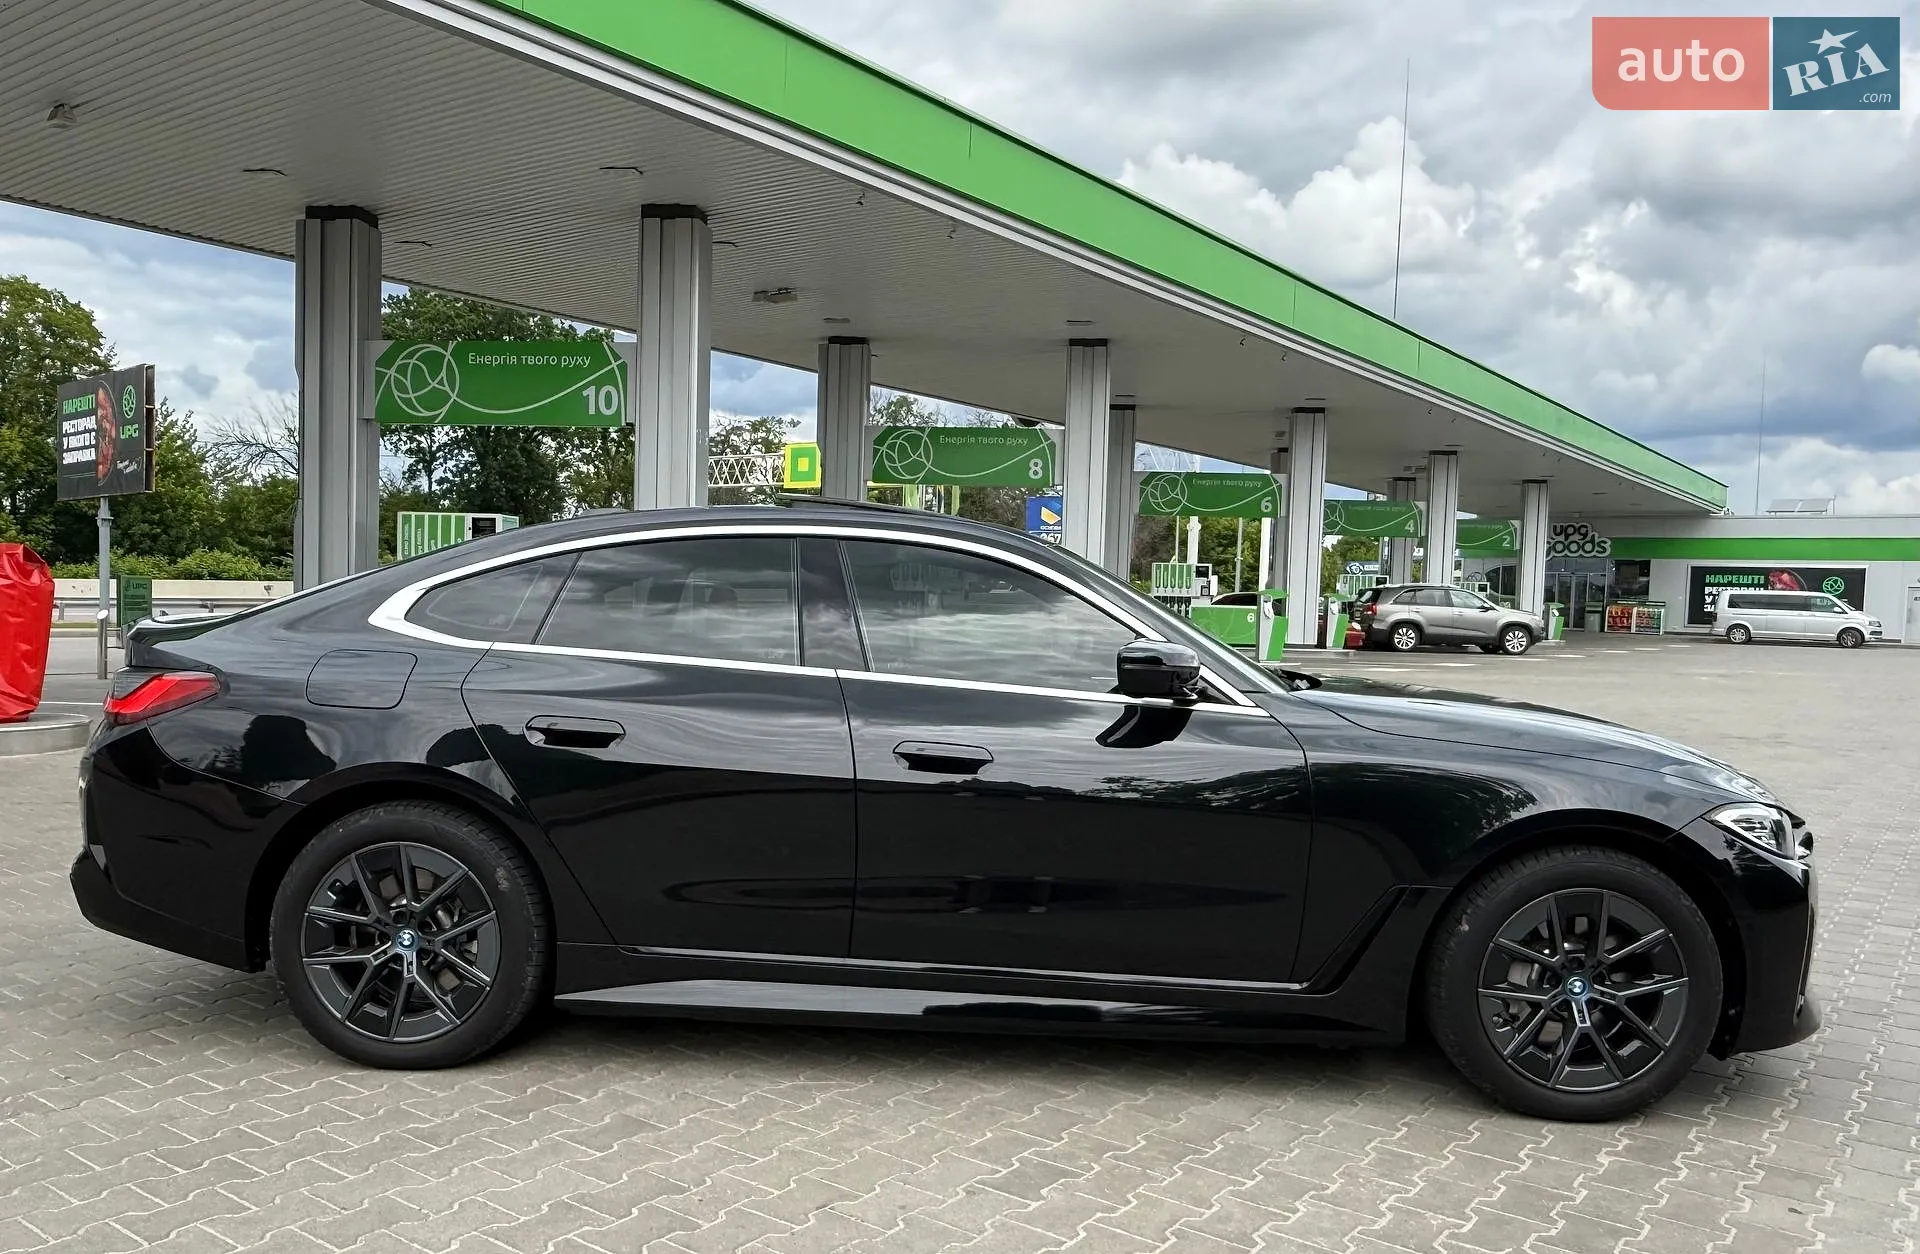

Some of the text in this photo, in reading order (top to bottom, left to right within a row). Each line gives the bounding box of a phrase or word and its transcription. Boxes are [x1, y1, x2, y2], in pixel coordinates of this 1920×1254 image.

[468, 352, 591, 368] Енергія твого руху
[582, 385, 619, 415] 10
[120, 423, 139, 439] UPG
[939, 435, 1028, 446] Енергія твого руху
[1029, 458, 1043, 480] 8
[1260, 496, 1273, 513] 6
[1404, 519, 1415, 533] 4
[1552, 524, 1589, 541] upg
[1502, 535, 1511, 547] 2
[1705, 574, 1765, 584] НАРЕШТІ
[1246, 613, 1255, 623] 6
